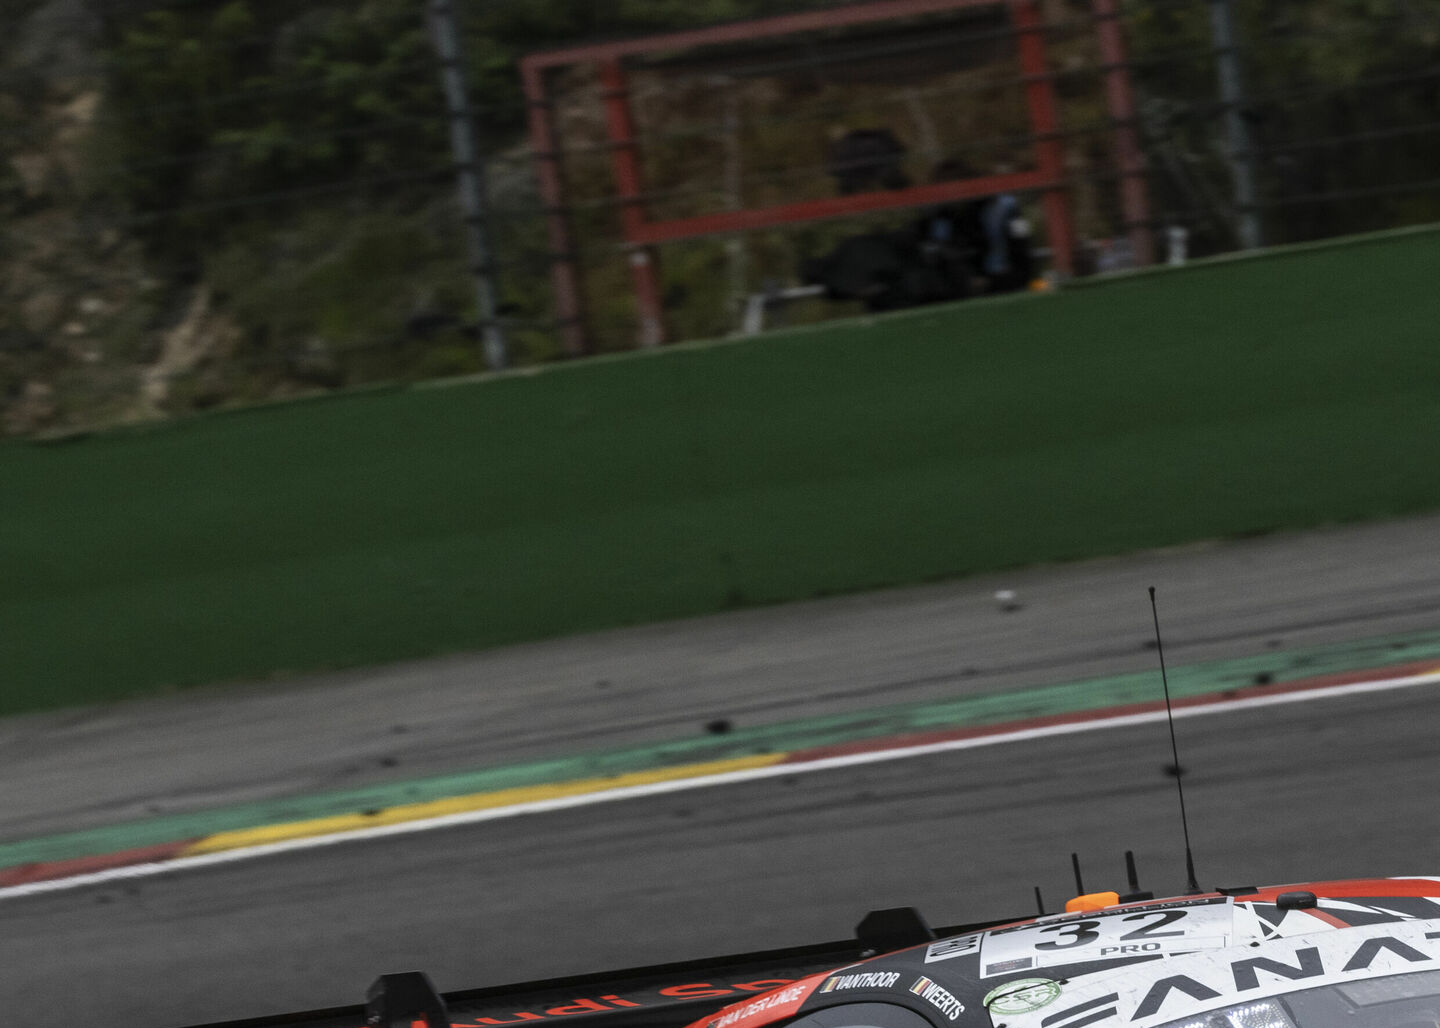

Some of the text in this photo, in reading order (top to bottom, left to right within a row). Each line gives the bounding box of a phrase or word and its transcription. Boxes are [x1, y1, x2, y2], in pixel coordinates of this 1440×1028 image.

[1035, 910, 1188, 951] 32
[1100, 941, 1162, 956] PRO
[835, 971, 900, 991] VANTHOOR
[920, 981, 966, 1021] WEERTS
